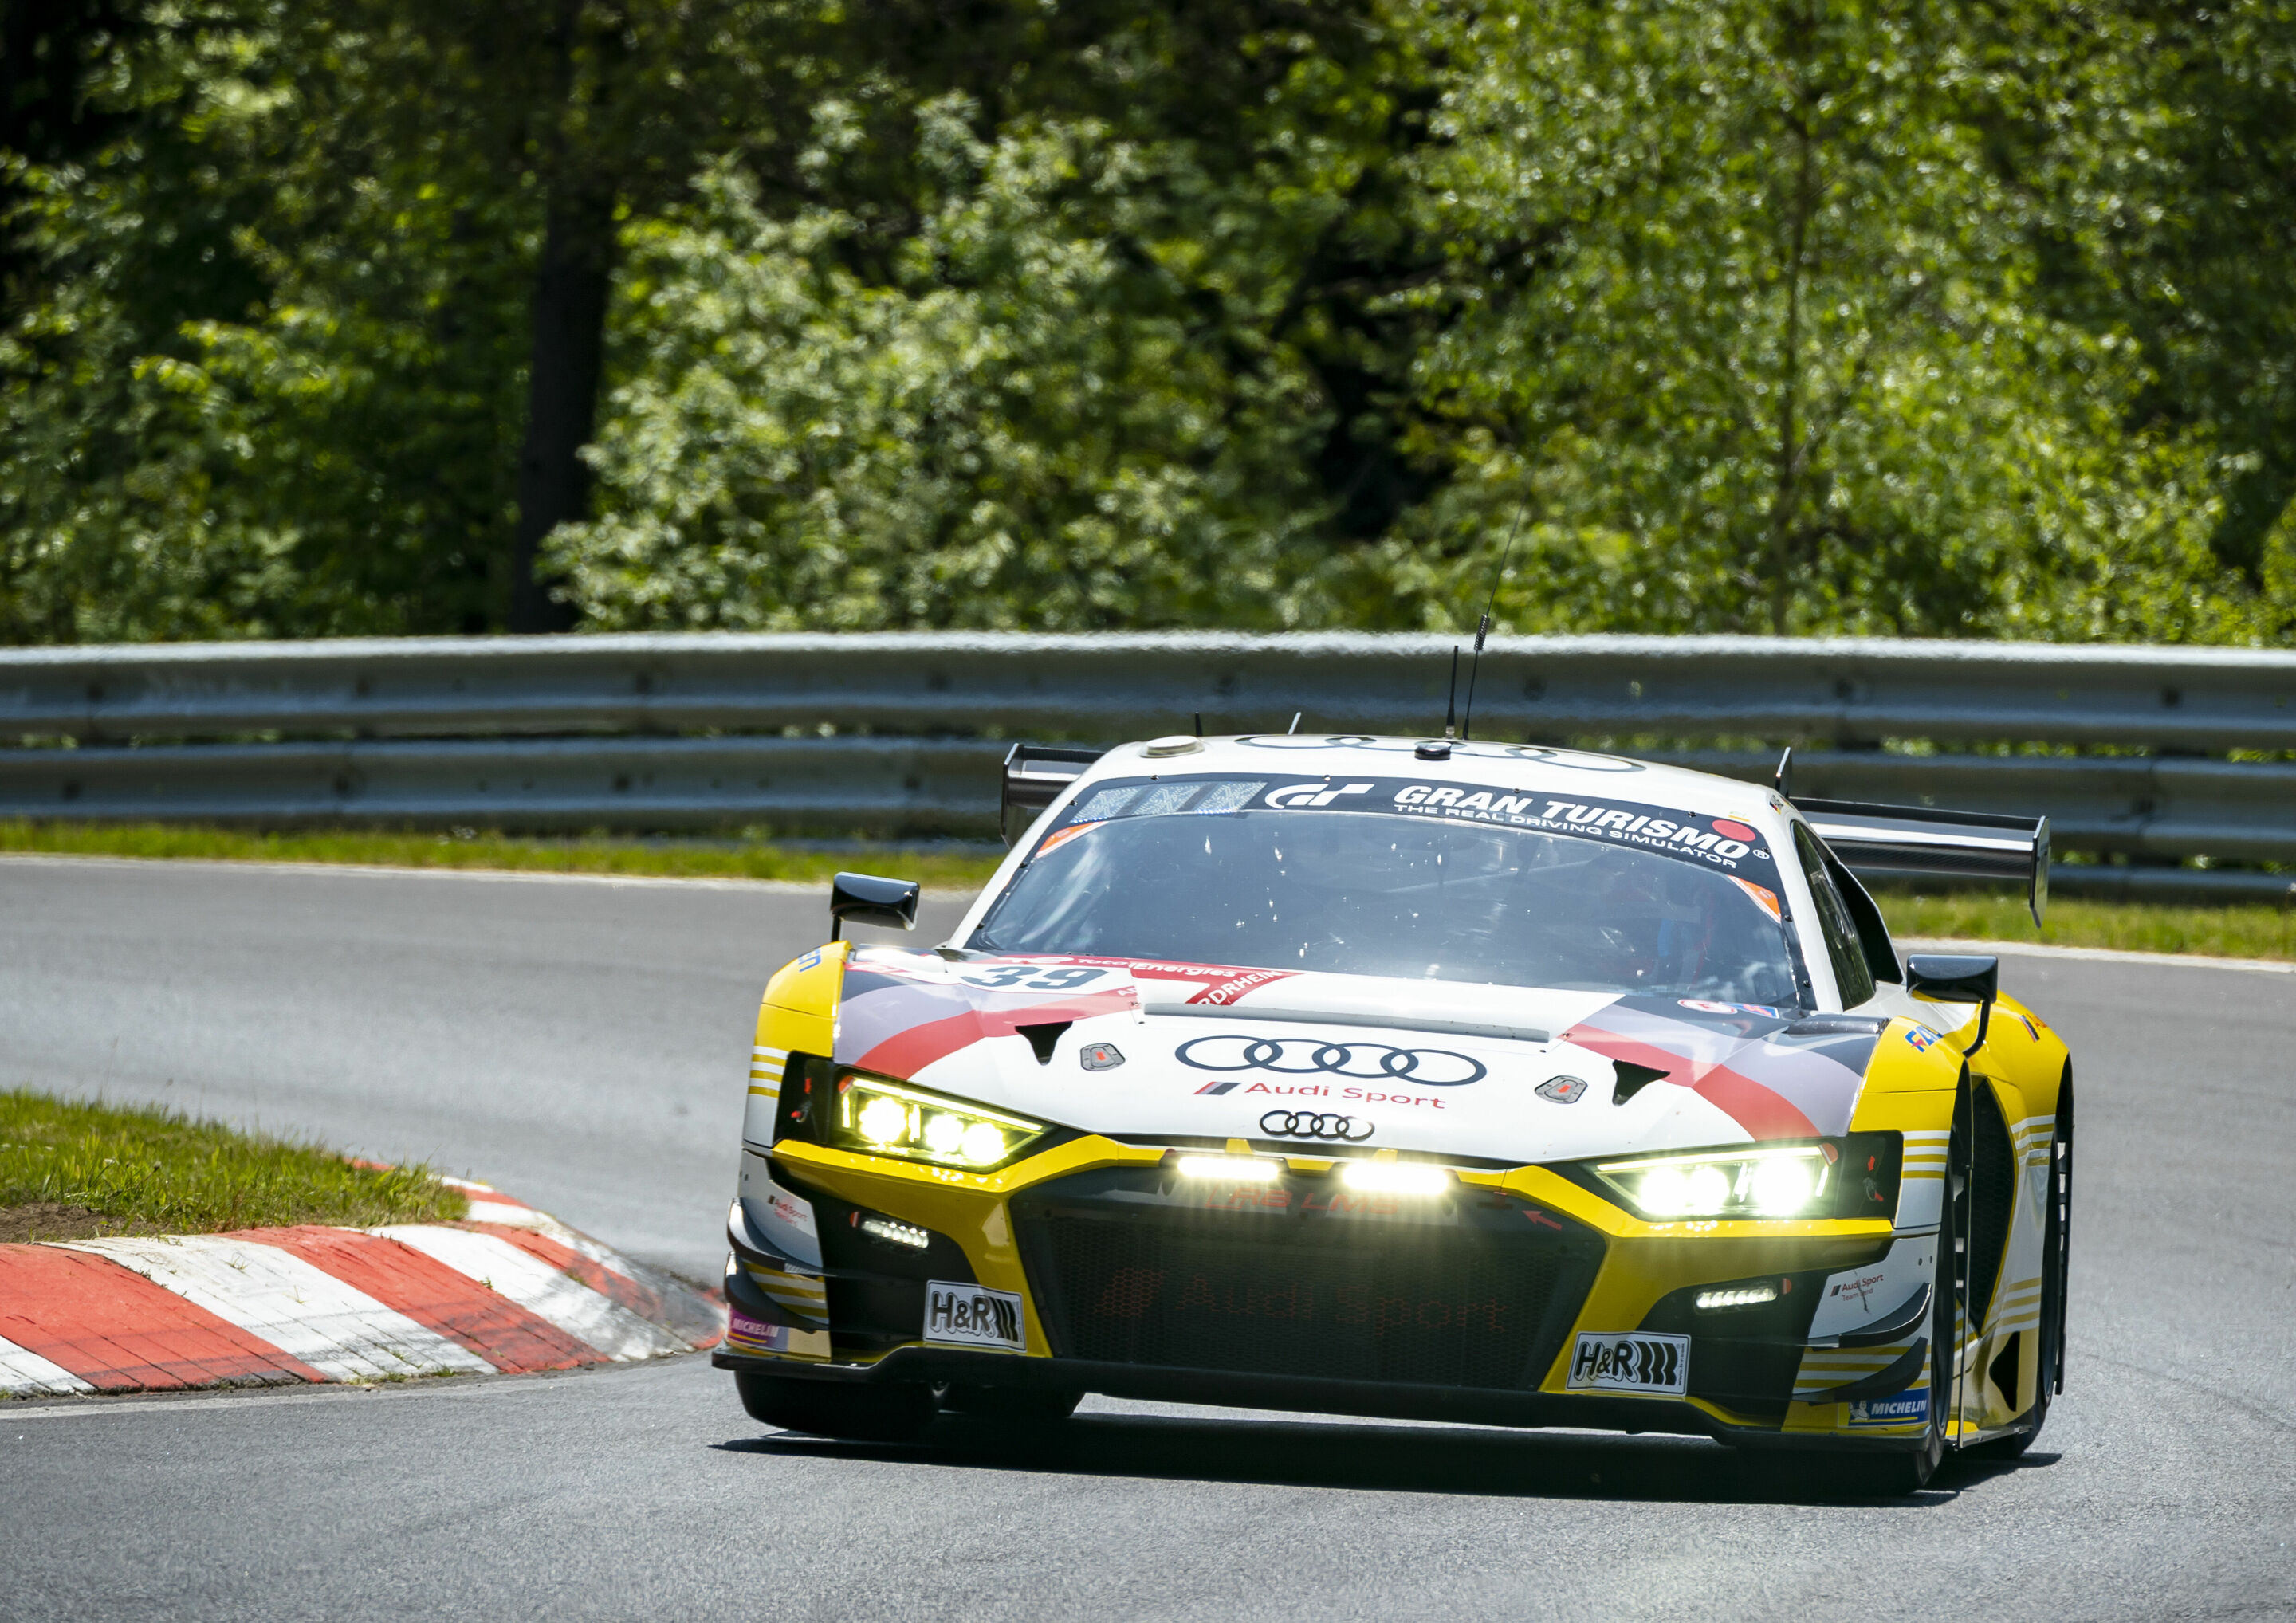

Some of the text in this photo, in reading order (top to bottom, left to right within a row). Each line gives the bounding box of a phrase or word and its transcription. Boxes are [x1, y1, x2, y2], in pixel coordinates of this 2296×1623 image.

[1394, 785, 1750, 859] GRAN TURISMO
[1394, 804, 1737, 868] THE REAL DRIVING SIMULATOR
[960, 966, 1109, 990] 39
[1079, 959, 1239, 977] TotalEnergies
[1244, 1083, 1446, 1109] Audi Sport
[1301, 1193, 1401, 1215] LMS
[1862, 1274, 1884, 1287] Sport
[931, 1292, 994, 1335] H&R
[1175, 1277, 1507, 1336] Audi Sport
[733, 1318, 779, 1338] MICHELIN
[1575, 1342, 1636, 1380] H&R
[1871, 1400, 1927, 1415] MICHELIN
